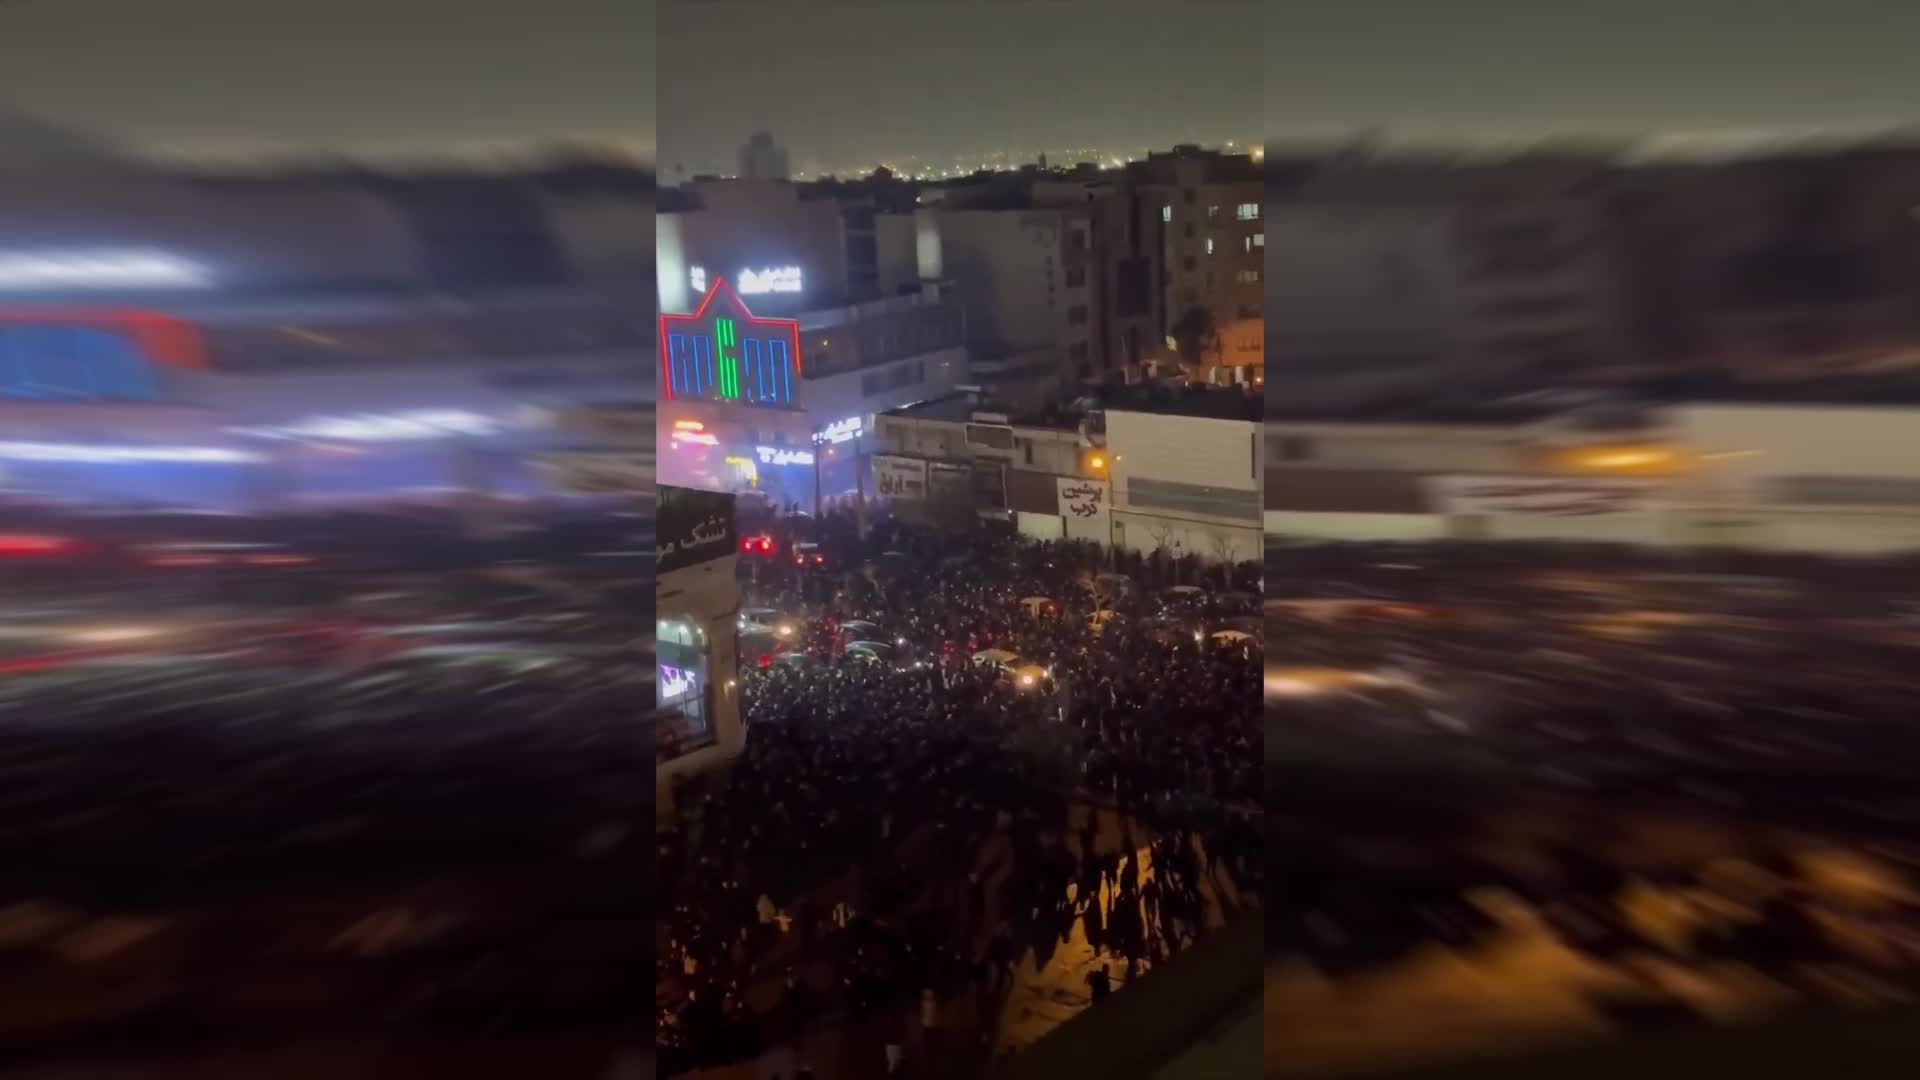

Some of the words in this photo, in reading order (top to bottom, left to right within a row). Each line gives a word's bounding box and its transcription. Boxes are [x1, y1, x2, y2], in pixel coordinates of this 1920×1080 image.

[1062, 482, 1103, 503] پرشین
[1070, 503, 1098, 517] درب
[680, 515, 726, 549] تشک
